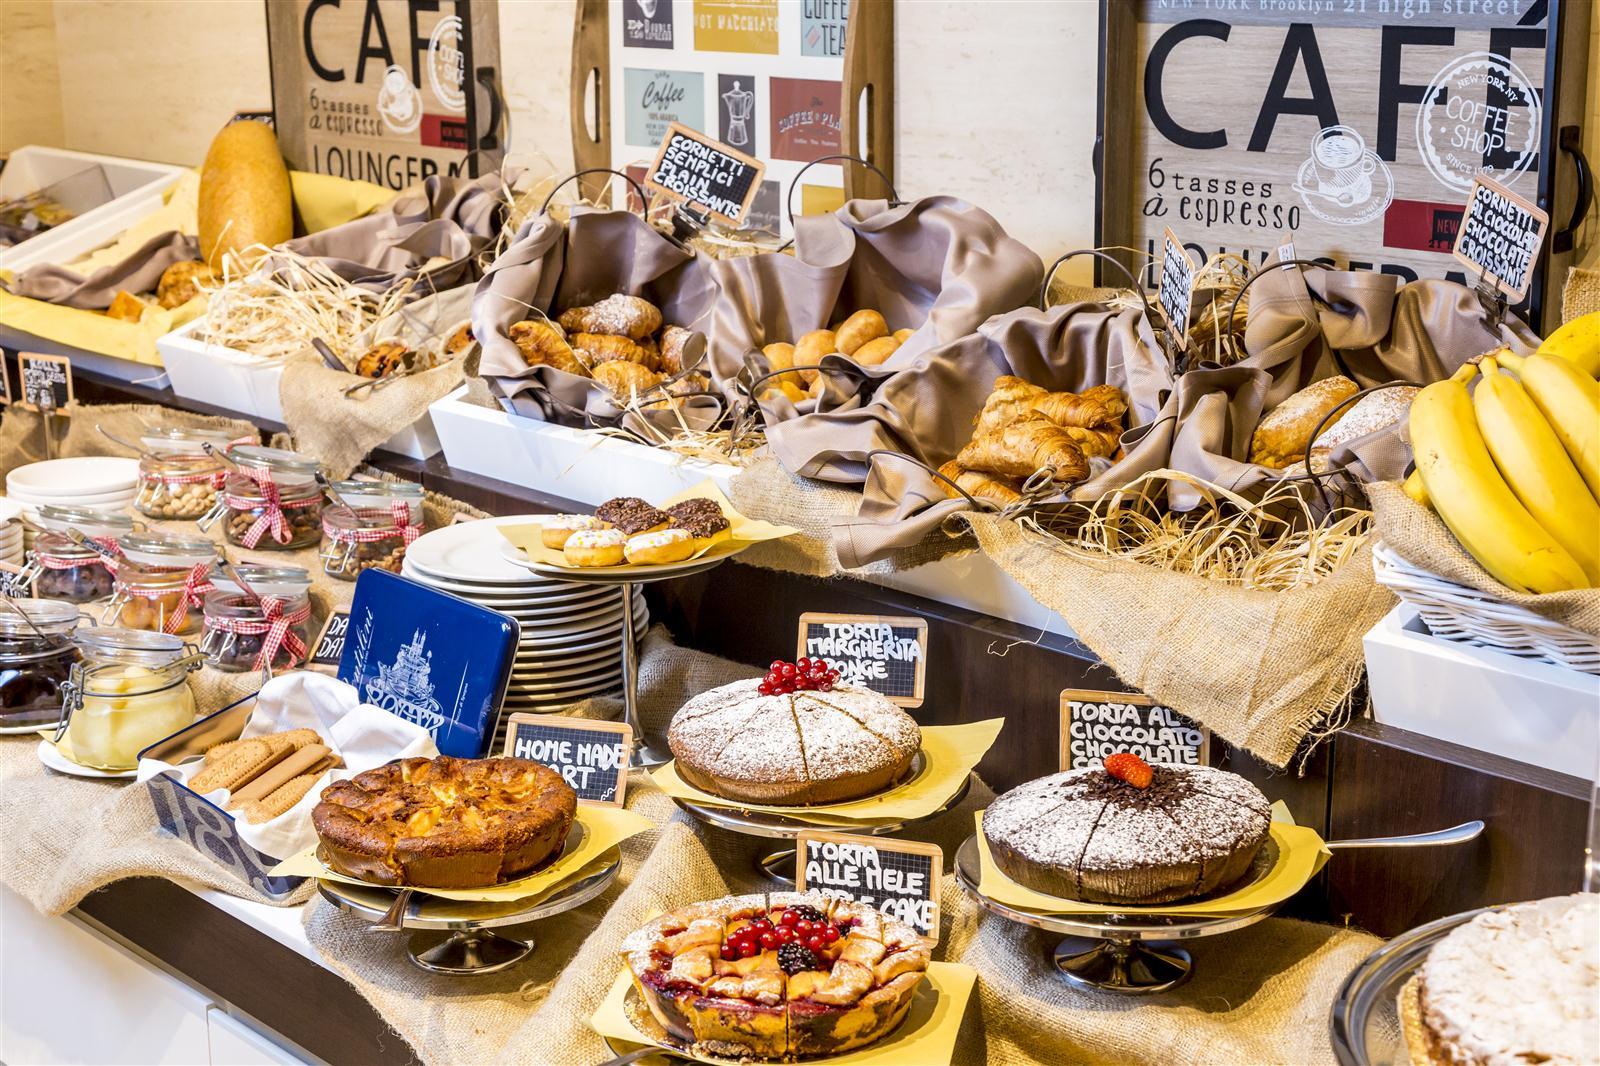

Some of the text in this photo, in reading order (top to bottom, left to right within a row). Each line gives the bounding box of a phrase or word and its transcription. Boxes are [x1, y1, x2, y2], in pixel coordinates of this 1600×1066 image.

[1203, 0, 1251, 11] YORK
[1260, 0, 1335, 14] Brooklyn
[1343, 0, 1366, 13] 21
[1378, 0, 1431, 19] high
[1443, 0, 1521, 15] street
[641, 81, 685, 111] Coffee
[1144, 0, 1546, 172] CAFÉ
[1457, 74, 1479, 89] NEW
[1504, 87, 1519, 102] NY
[309, 87, 370, 116] 6 tasses
[1446, 96, 1521, 136] COFFEE
[326, 113, 385, 137] espresso
[1450, 124, 1504, 157] SHOP
[659, 159, 711, 192] PLAIN
[1149, 157, 1273, 198] 6 tasses
[1446, 152, 1473, 174] SINCE
[653, 171, 742, 220] CROISSANTS
[1470, 199, 1484, 220] AL
[1476, 185, 1535, 232] CORNETTI
[1179, 196, 1301, 231] espresso
[1436, 219, 1460, 235] NEW
[1465, 217, 1533, 272] CHOCOLATE
[823, 622, 894, 641] TORTA
[807, 635, 924, 664] MARGHERITA
[1067, 701, 1181, 727] TORTA AL
[1070, 721, 1205, 746] CIOCCOLATO
[514, 737, 629, 771] HOME MADE
[806, 840, 881, 868] TORTA
[806, 860, 925, 895] ALLE MELE
[880, 897, 938, 930] CAKE
